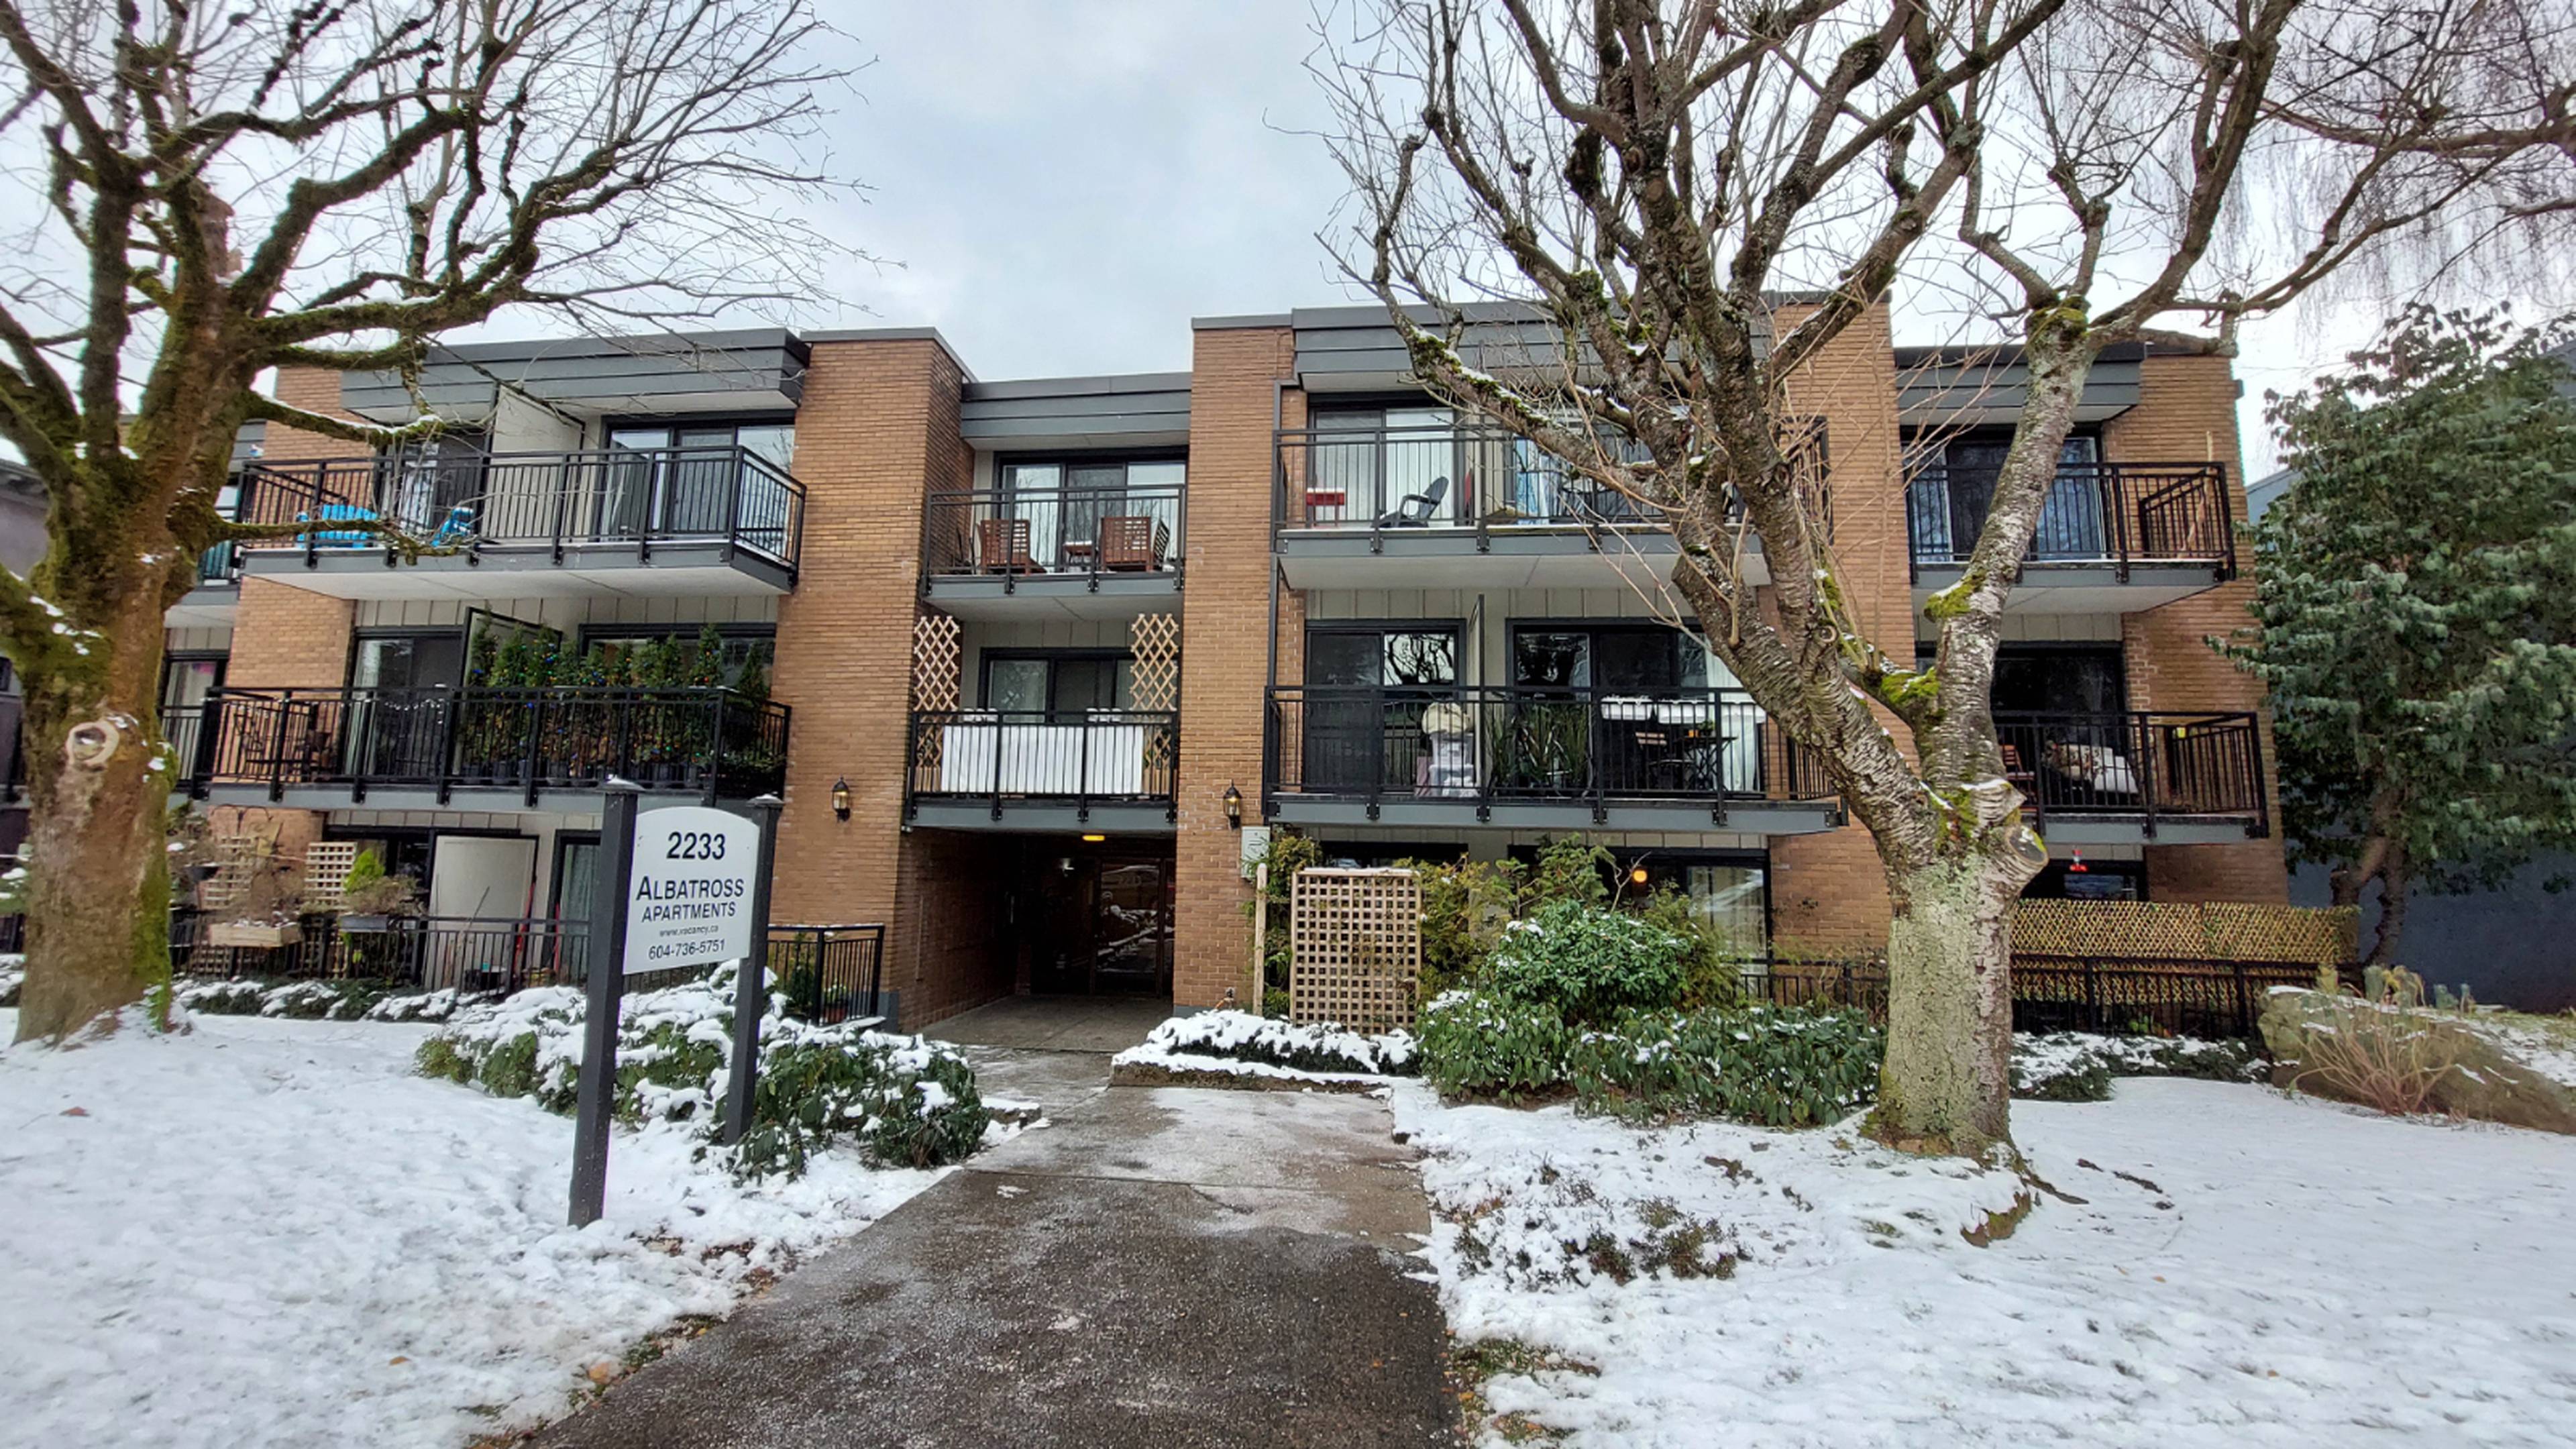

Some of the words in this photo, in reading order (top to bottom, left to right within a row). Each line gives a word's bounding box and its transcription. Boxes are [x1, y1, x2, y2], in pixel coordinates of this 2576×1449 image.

[667, 831, 725, 859] 2233
[637, 875, 743, 900] ALBATROSS
[642, 902, 736, 922] APARTMENTS
[659, 925, 718, 937] www.vacancy.ca
[649, 938, 724, 960] 604-736-5751
